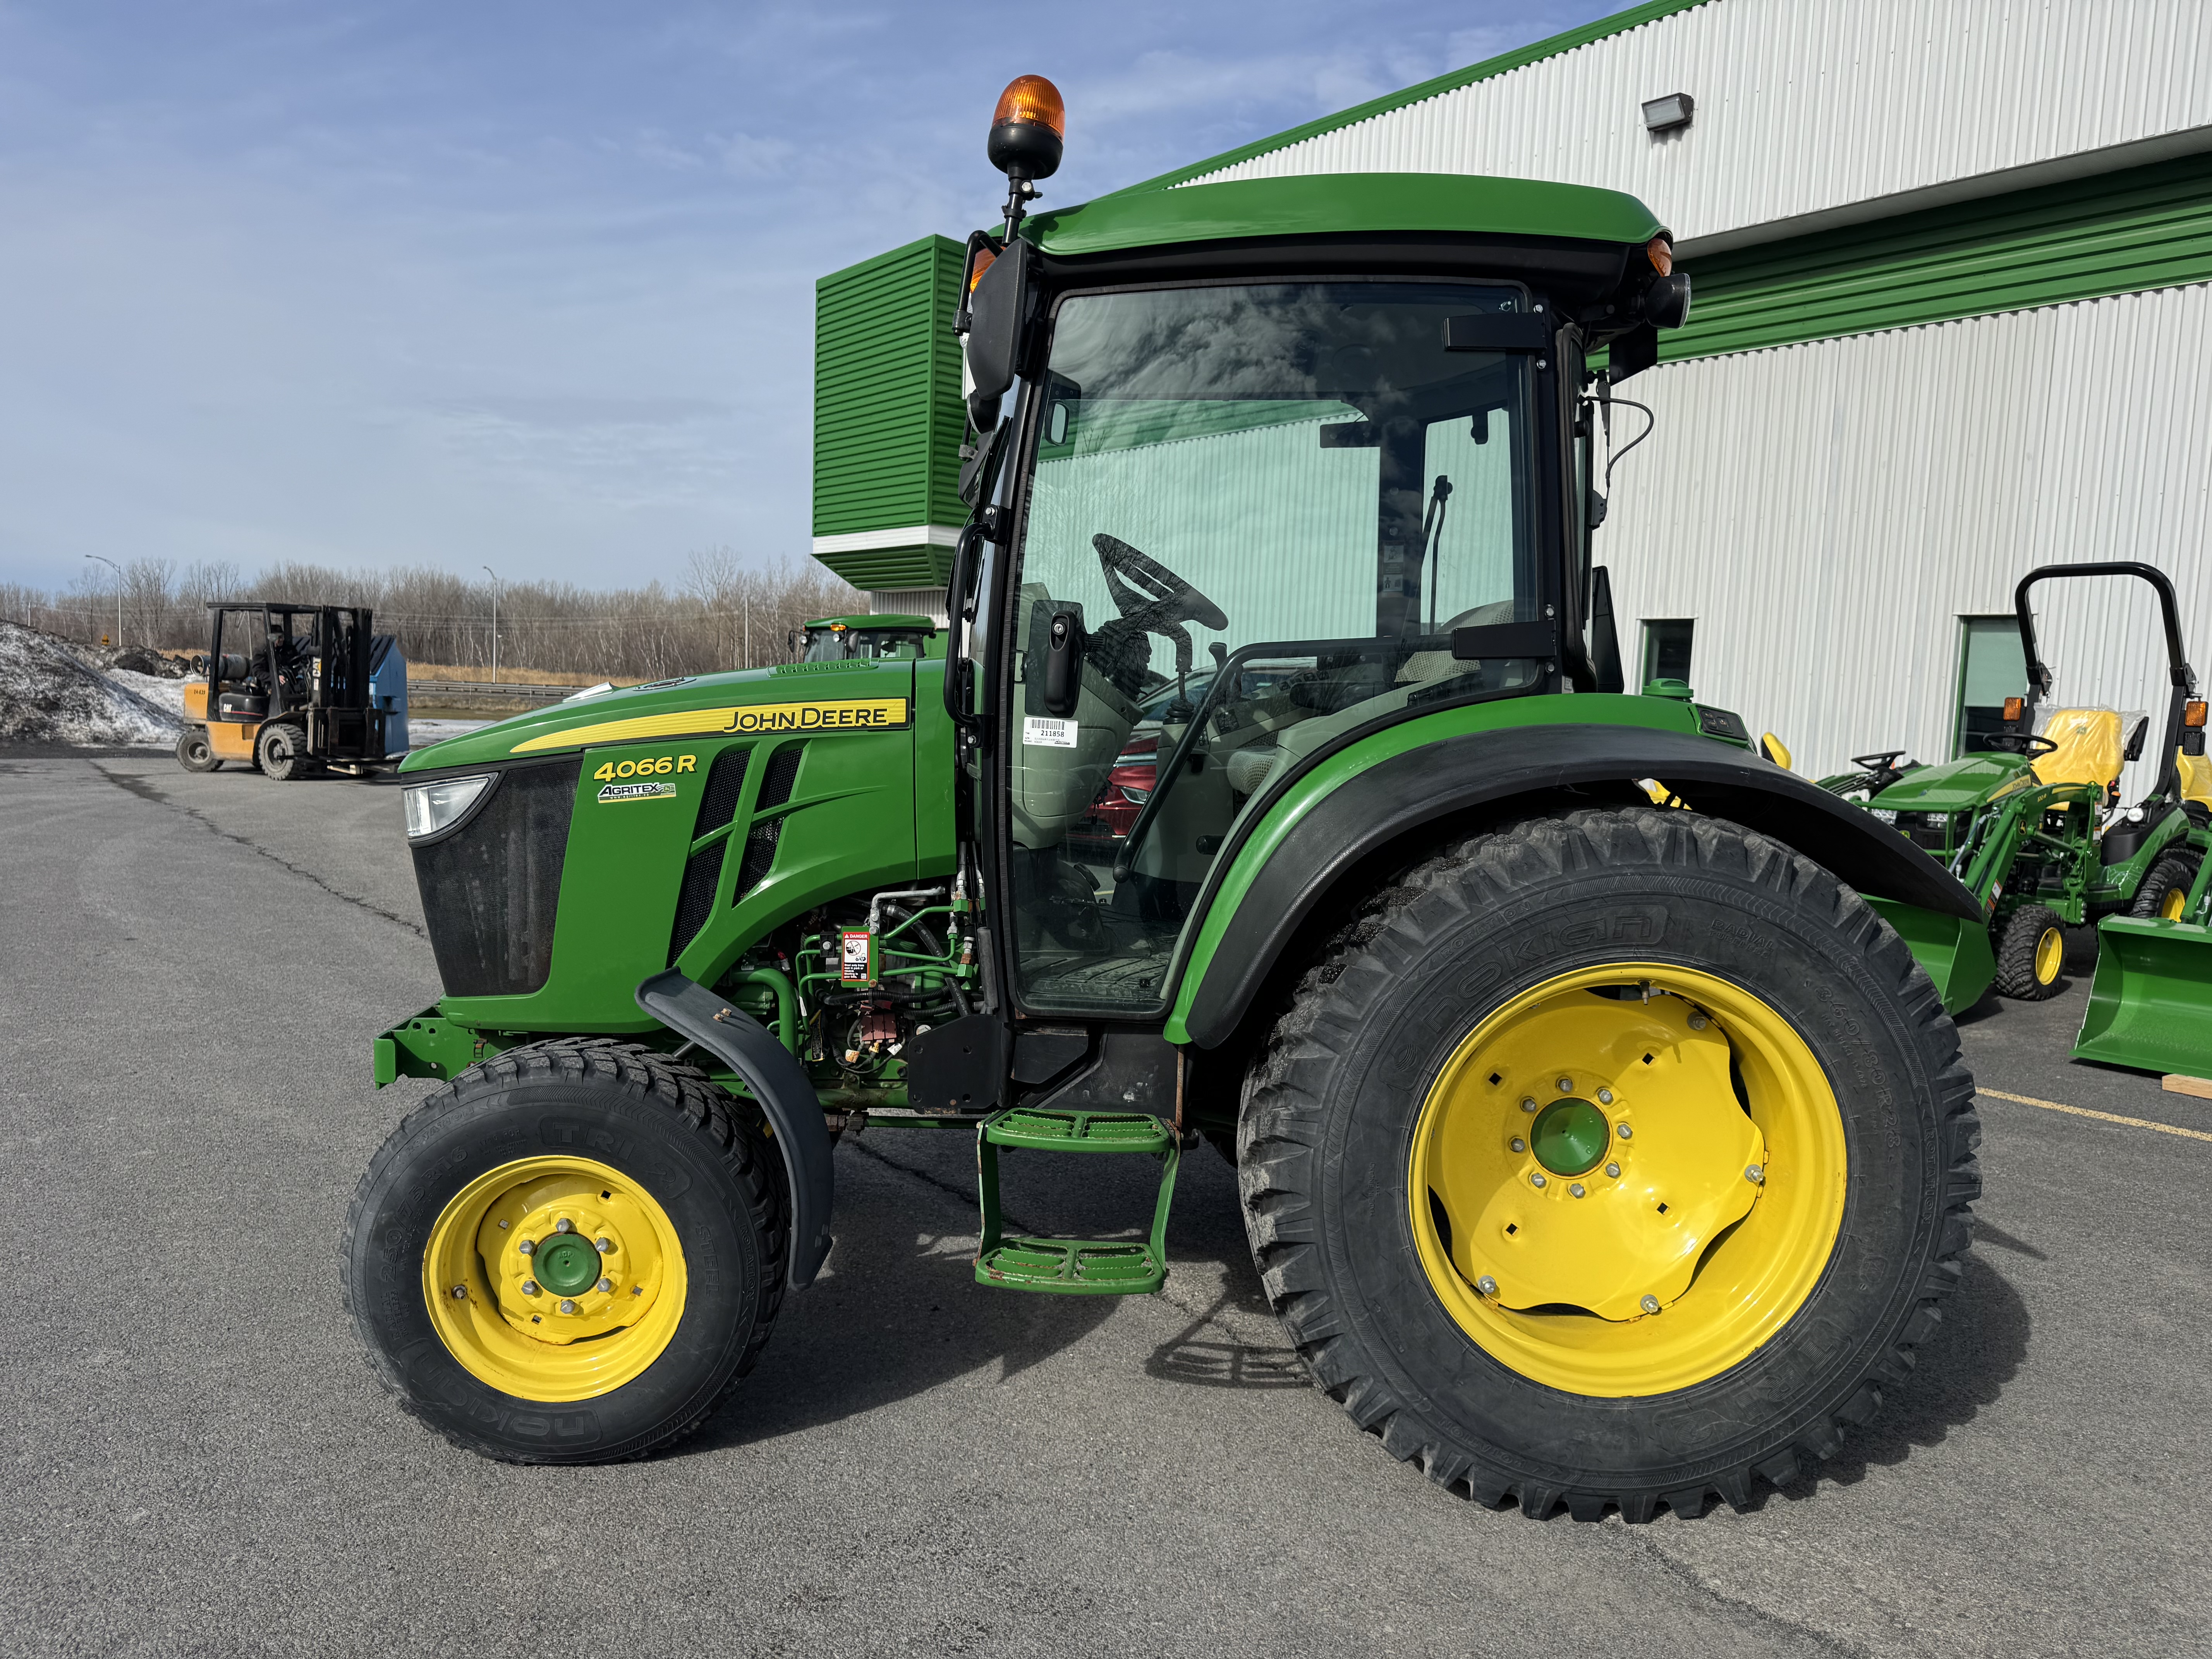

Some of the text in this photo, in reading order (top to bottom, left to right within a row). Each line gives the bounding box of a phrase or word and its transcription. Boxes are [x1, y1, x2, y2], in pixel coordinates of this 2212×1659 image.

[223, 703, 232, 713] CAT
[724, 708, 888, 730] JOHN DEERE
[599, 783, 659, 796] AGRITEX
[1440, 900, 1532, 961] ROTATION
[1711, 918, 1774, 953] RADIAL
[405, 1101, 475, 1156] ROTATION
[554, 1122, 637, 1161] TRI
[1921, 1127, 1936, 1225] ROTATION
[695, 1226, 720, 1297] STEEL
[738, 1223, 756, 1301] ROTATION
[380, 1291, 402, 1341] RADIAL
[1732, 1338, 1840, 1422] TRI
[1437, 1417, 1528, 1469] ROTATION
